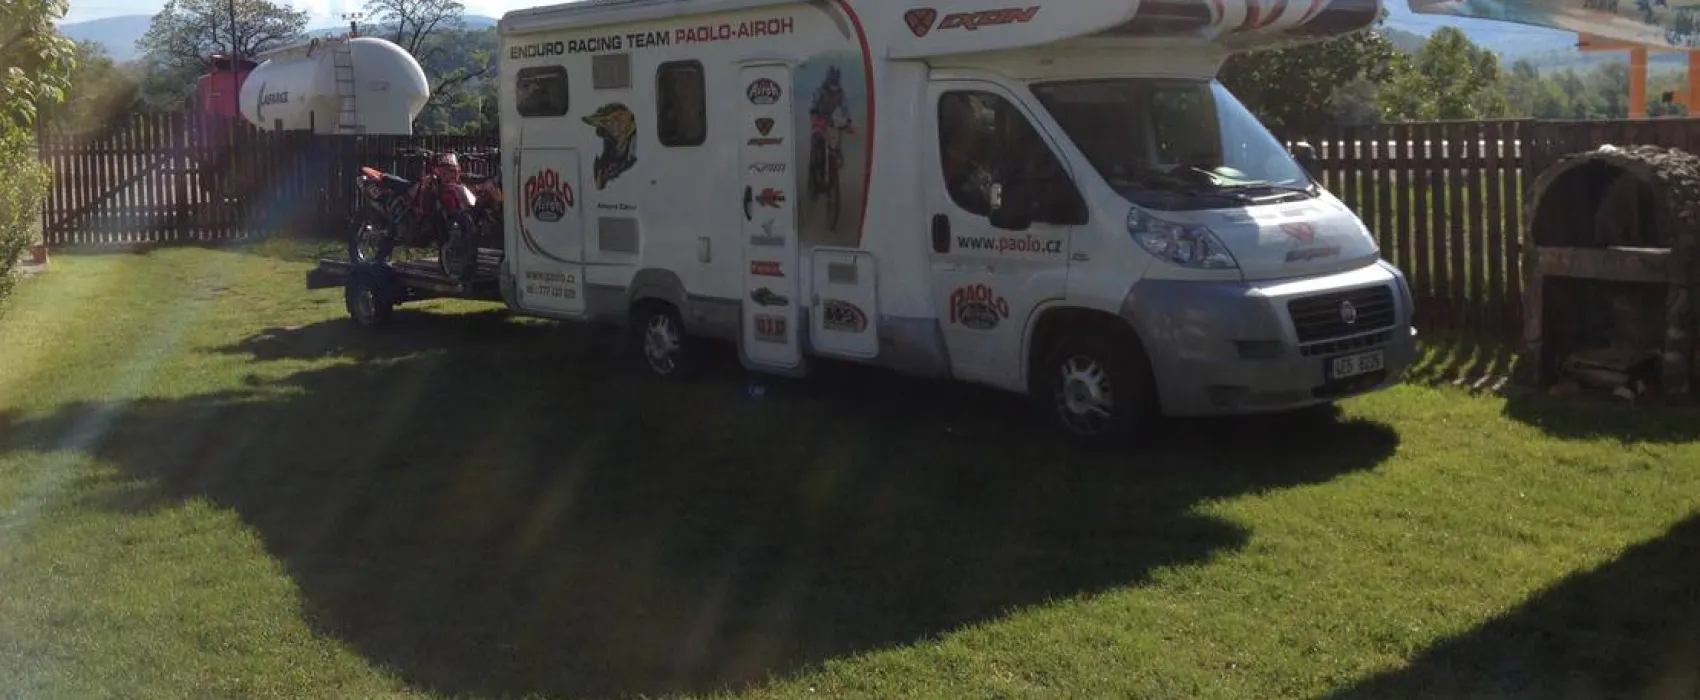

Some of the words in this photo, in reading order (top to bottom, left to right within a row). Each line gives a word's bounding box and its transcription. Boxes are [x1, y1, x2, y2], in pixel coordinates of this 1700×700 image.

[510, 42, 565, 60] ENDURO
[568, 34, 622, 54] RACING
[626, 30, 671, 49] TEAM
[675, 17, 795, 45] PAOLO-AIROH
[525, 168, 574, 217] PAOLO
[957, 233, 1062, 254] www.paolo.cz
[950, 283, 1009, 323] PAOLO
